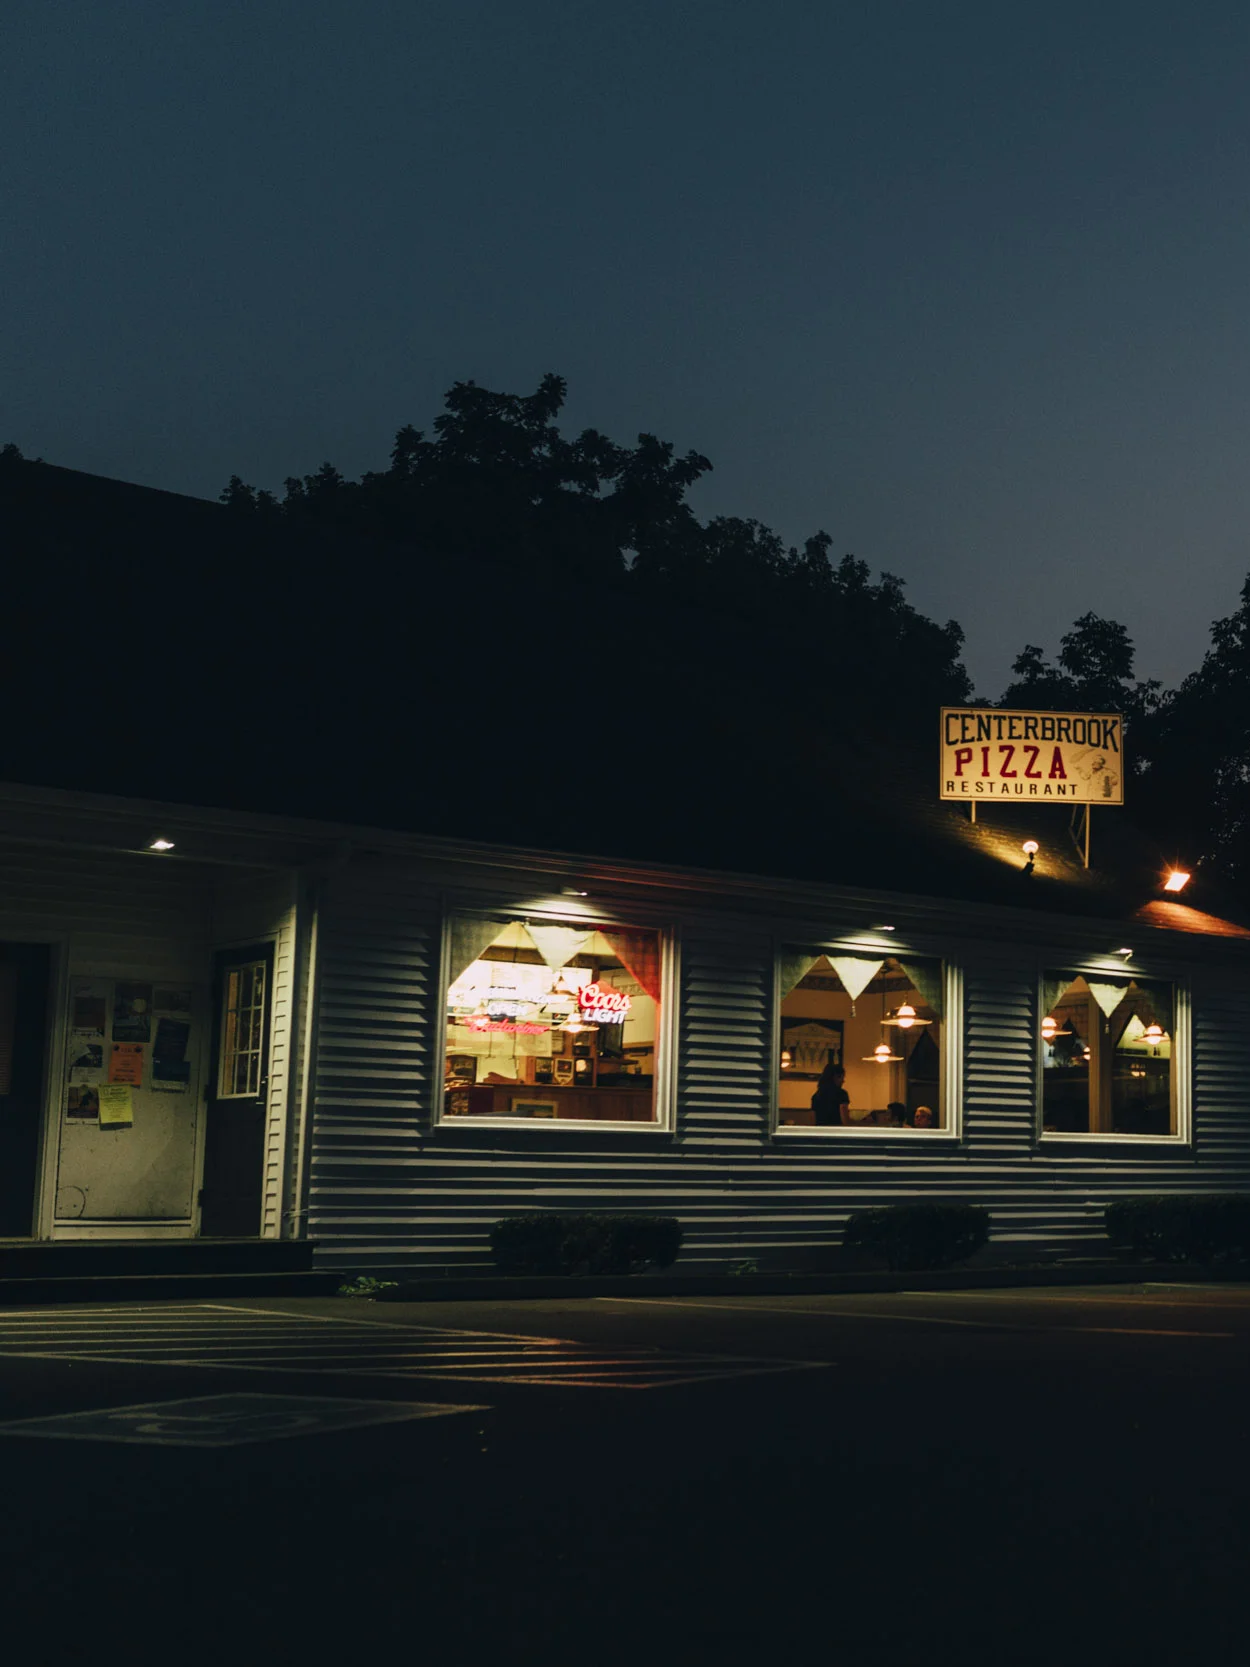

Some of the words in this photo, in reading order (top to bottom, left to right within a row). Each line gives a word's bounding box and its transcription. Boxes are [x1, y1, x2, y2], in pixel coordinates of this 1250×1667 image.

[945, 713, 1119, 752] CENTERBROOK
[954, 745, 1067, 779] PIZZA
[946, 780, 1078, 795] RESTAURANT
[580, 983, 632, 1010] Coors
[584, 1008, 628, 1024] LIGHT
